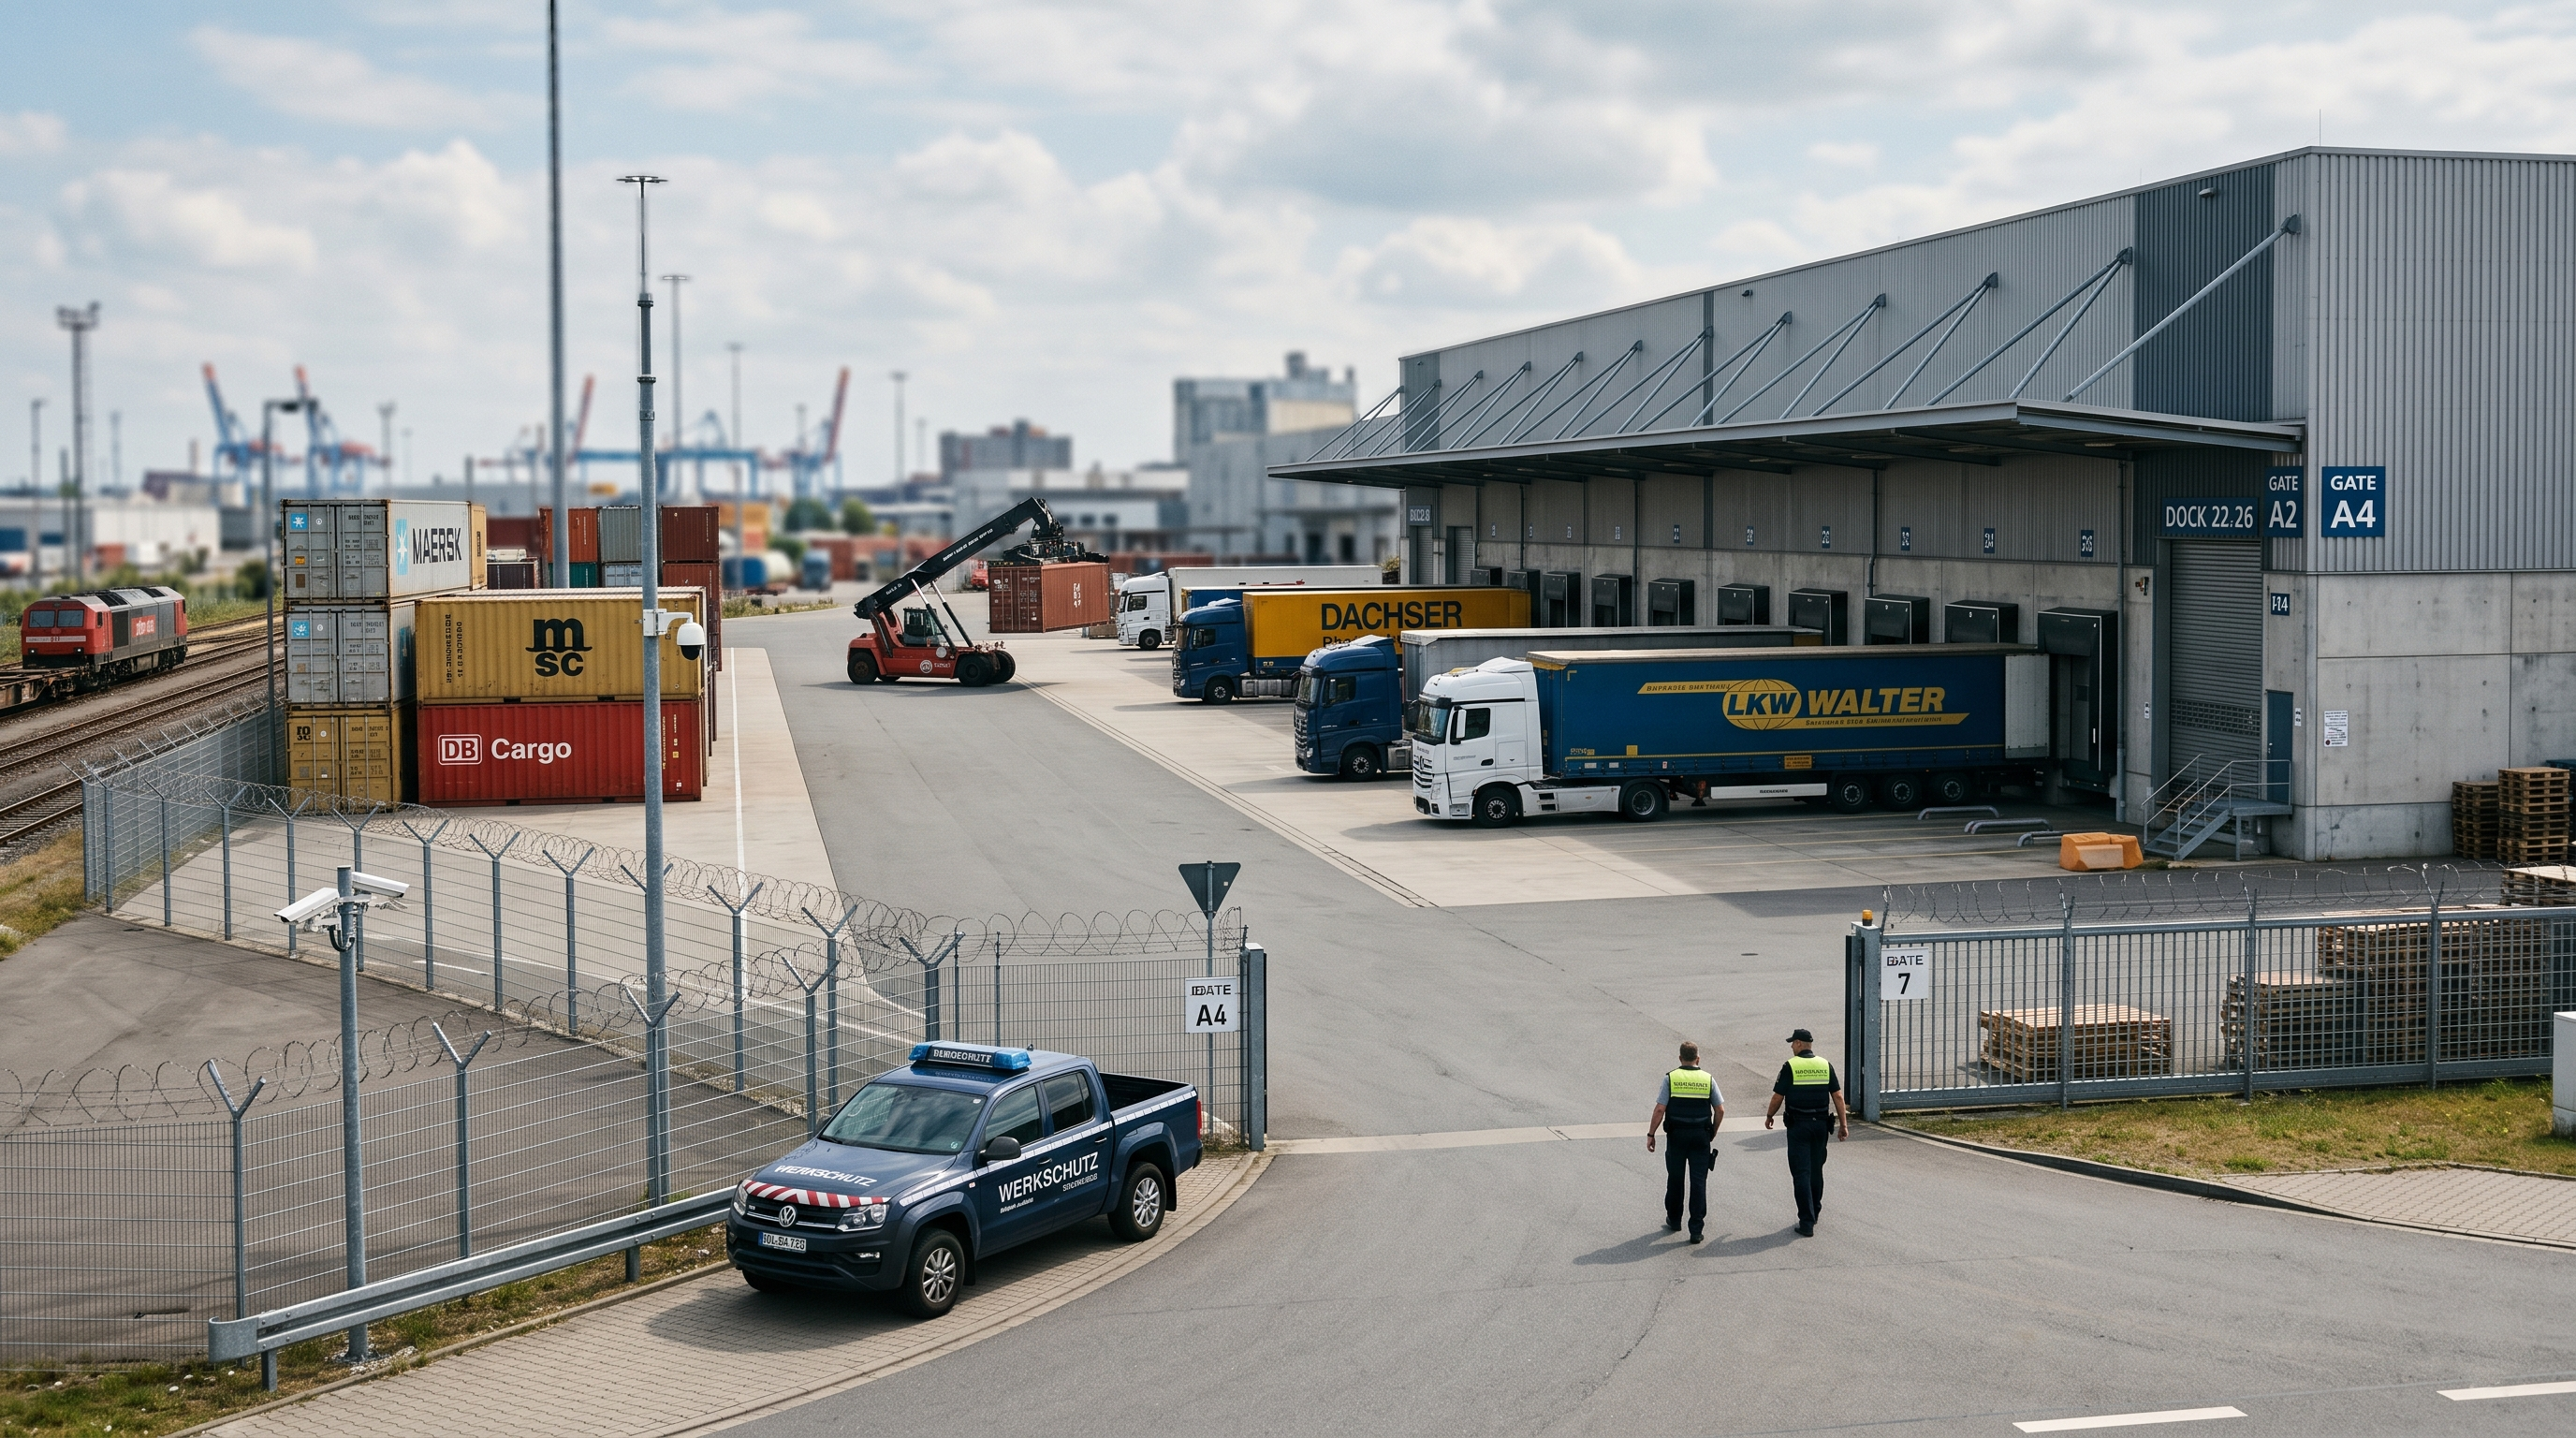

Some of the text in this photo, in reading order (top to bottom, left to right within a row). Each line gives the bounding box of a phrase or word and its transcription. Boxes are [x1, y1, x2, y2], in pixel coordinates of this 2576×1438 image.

[2268, 476, 2299, 491] GATE
[2330, 475, 2377, 491] GATE
[2165, 506, 2207, 528] DOCK
[2268, 500, 2297, 528] A2
[2330, 499, 2376, 528] A4
[412, 527, 462, 565] MAERSK
[1321, 600, 1463, 631] DACHSER
[1726, 686, 1946, 716] LKW WALTER
[443, 738, 572, 765] DB Cargo
[1897, 972, 1911, 995] 7
[1195, 1004, 1227, 1027] A4
[998, 1151, 1099, 1203] WERKSCHUTZ
